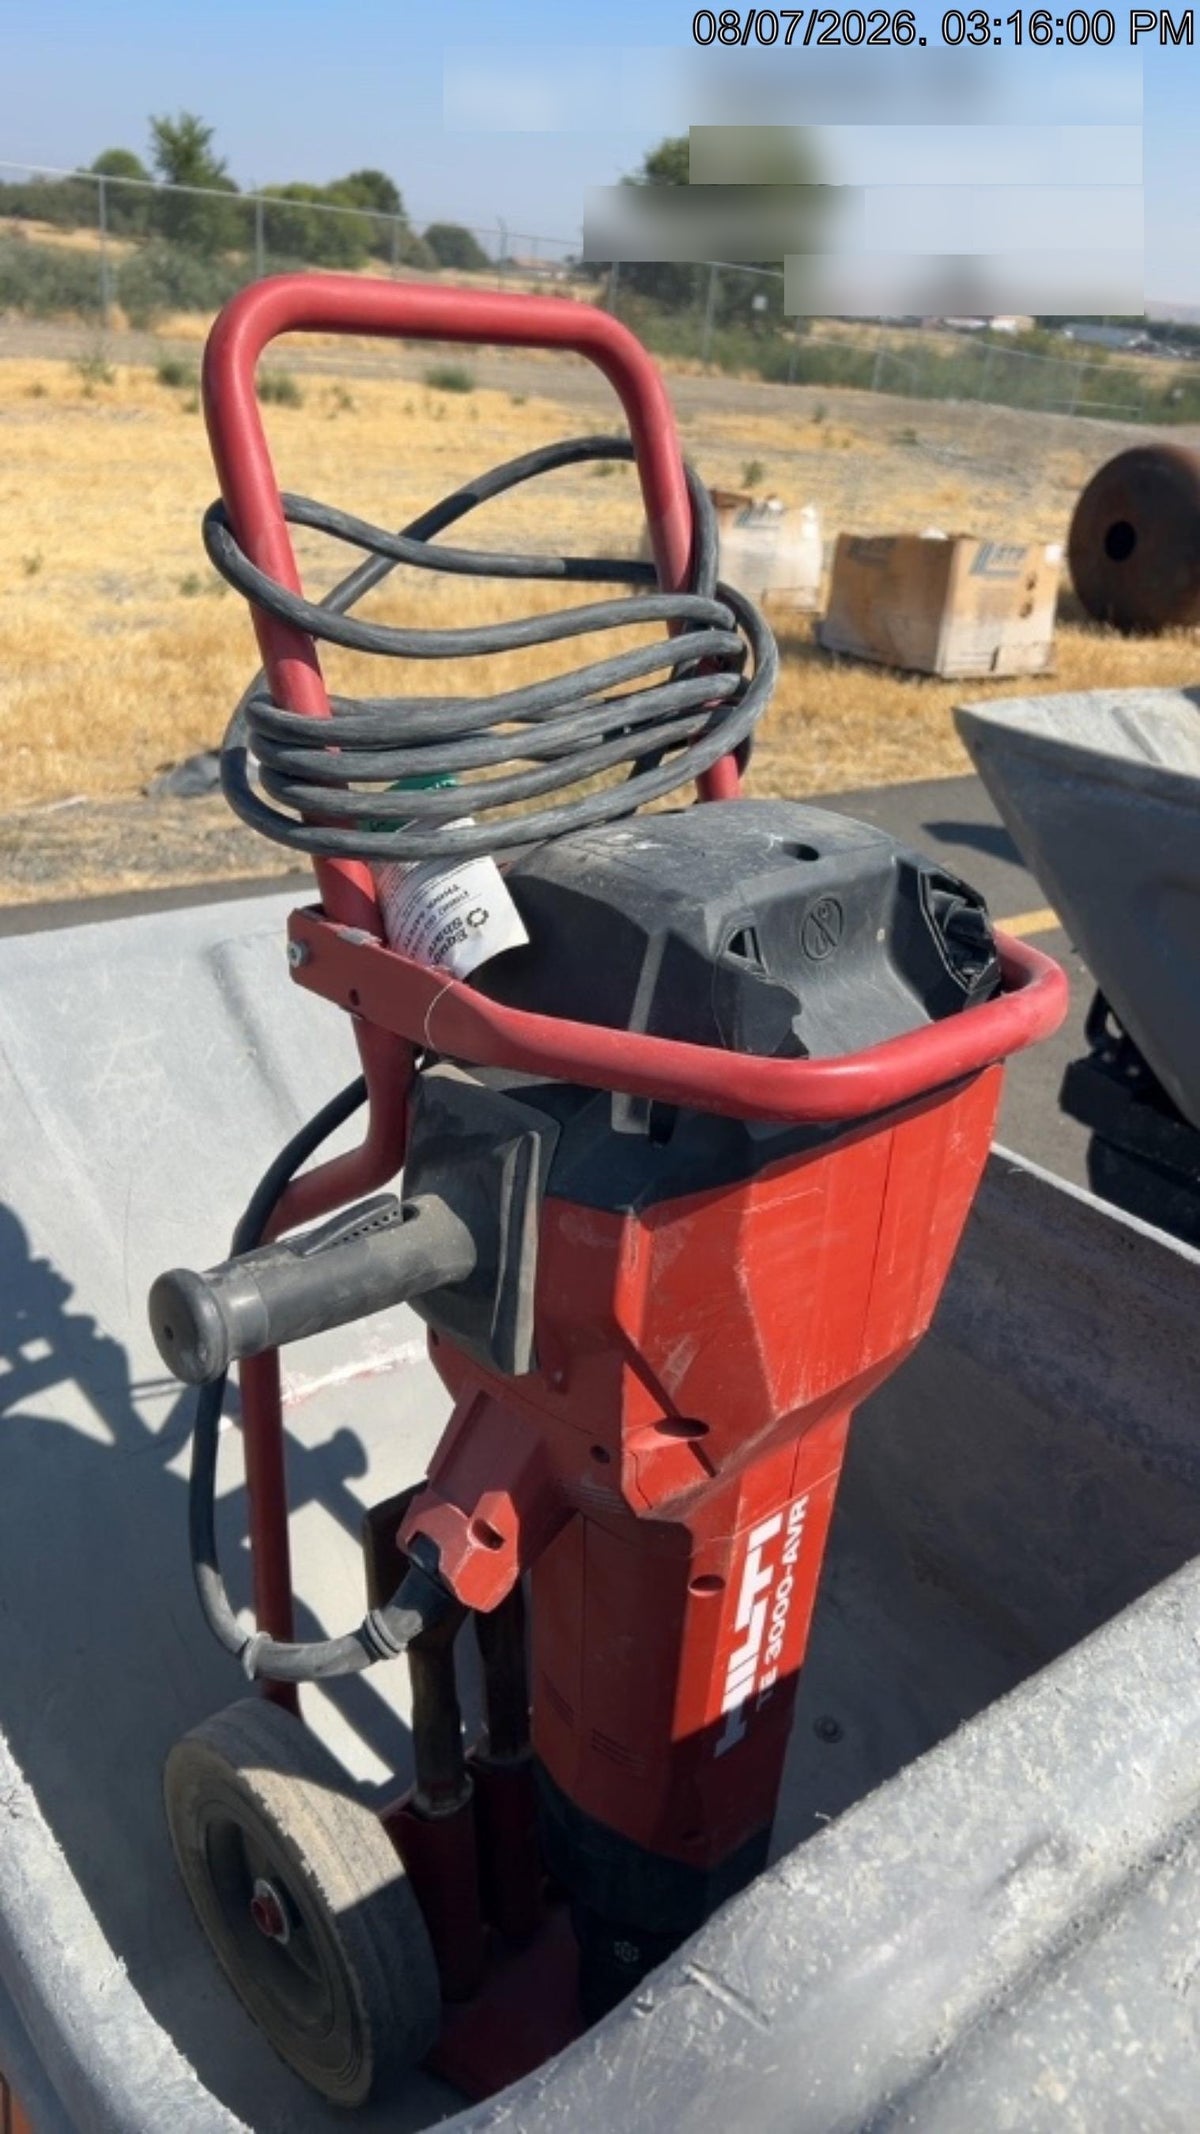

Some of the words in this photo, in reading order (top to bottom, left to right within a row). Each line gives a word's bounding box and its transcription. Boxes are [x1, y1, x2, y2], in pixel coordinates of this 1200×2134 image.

[713, 1511, 783, 1759] HILTI
[763, 1495, 809, 1665] 3000-AVR
[756, 1664, 779, 1712] TE
